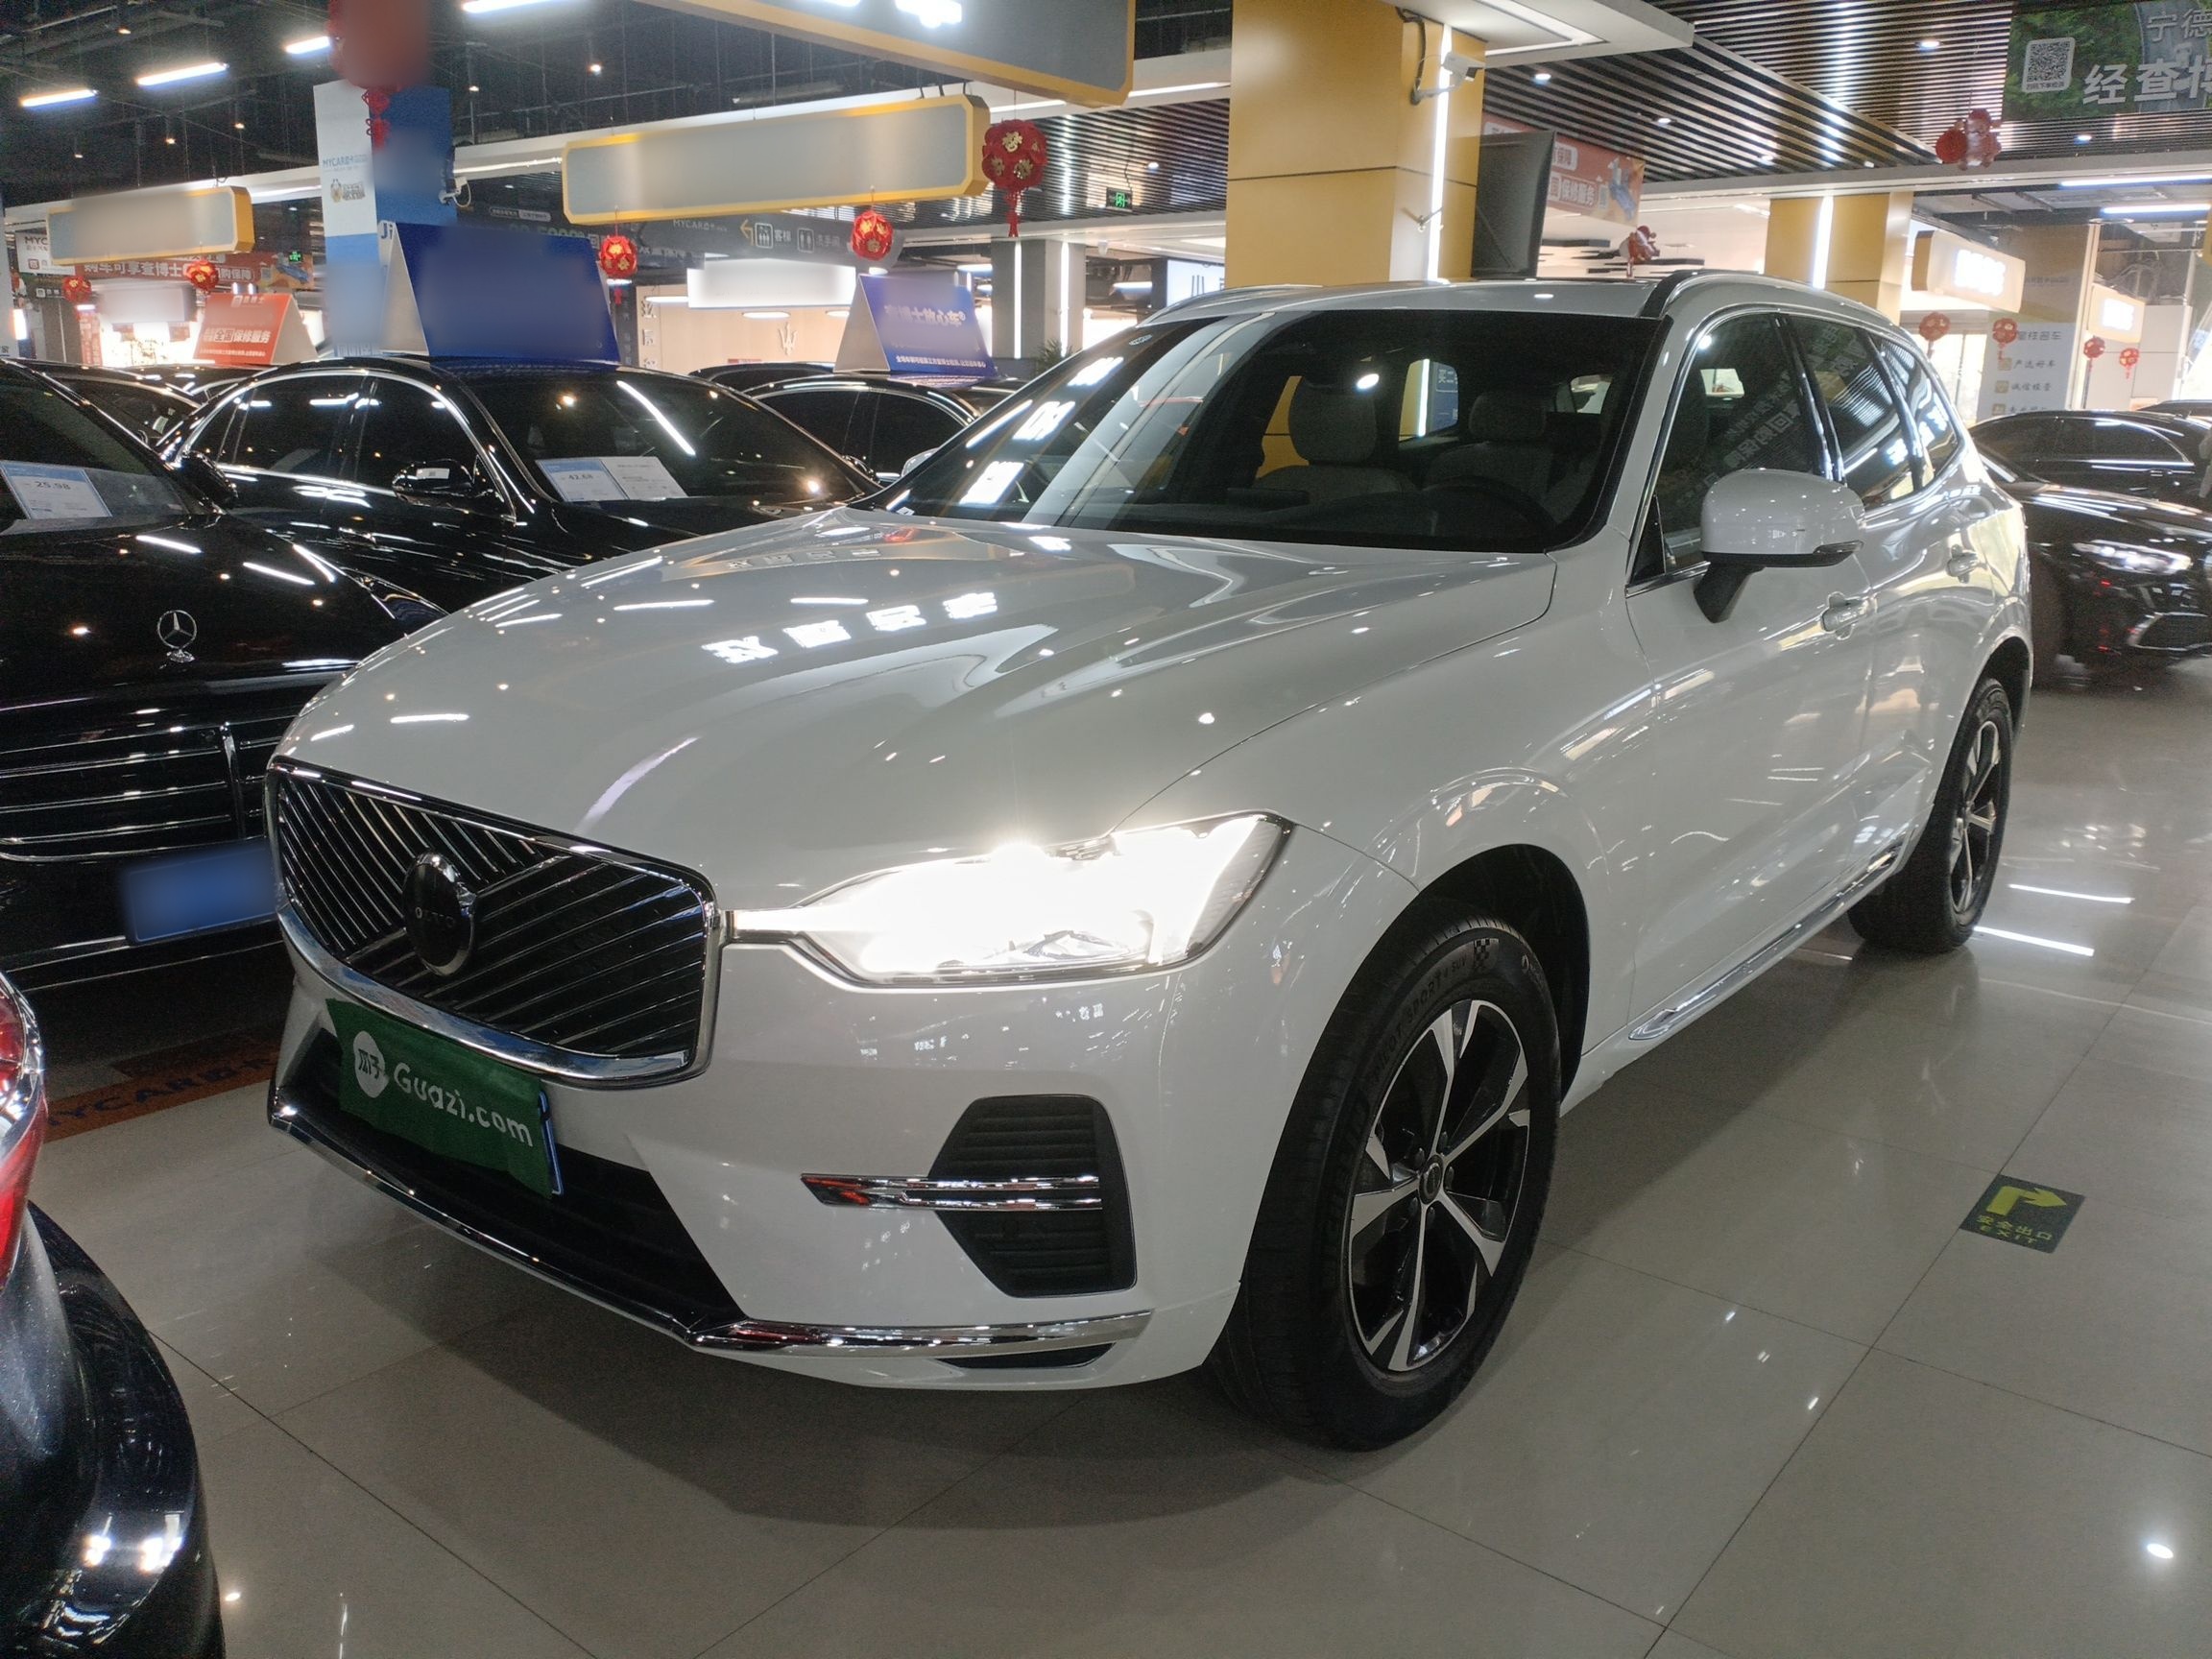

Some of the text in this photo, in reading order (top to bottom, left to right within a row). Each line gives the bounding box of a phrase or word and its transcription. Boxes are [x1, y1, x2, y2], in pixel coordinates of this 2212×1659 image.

[2147, 9, 2212, 42] 宁德
[357, 1048, 534, 1147] 瓜子 Guazi.com
